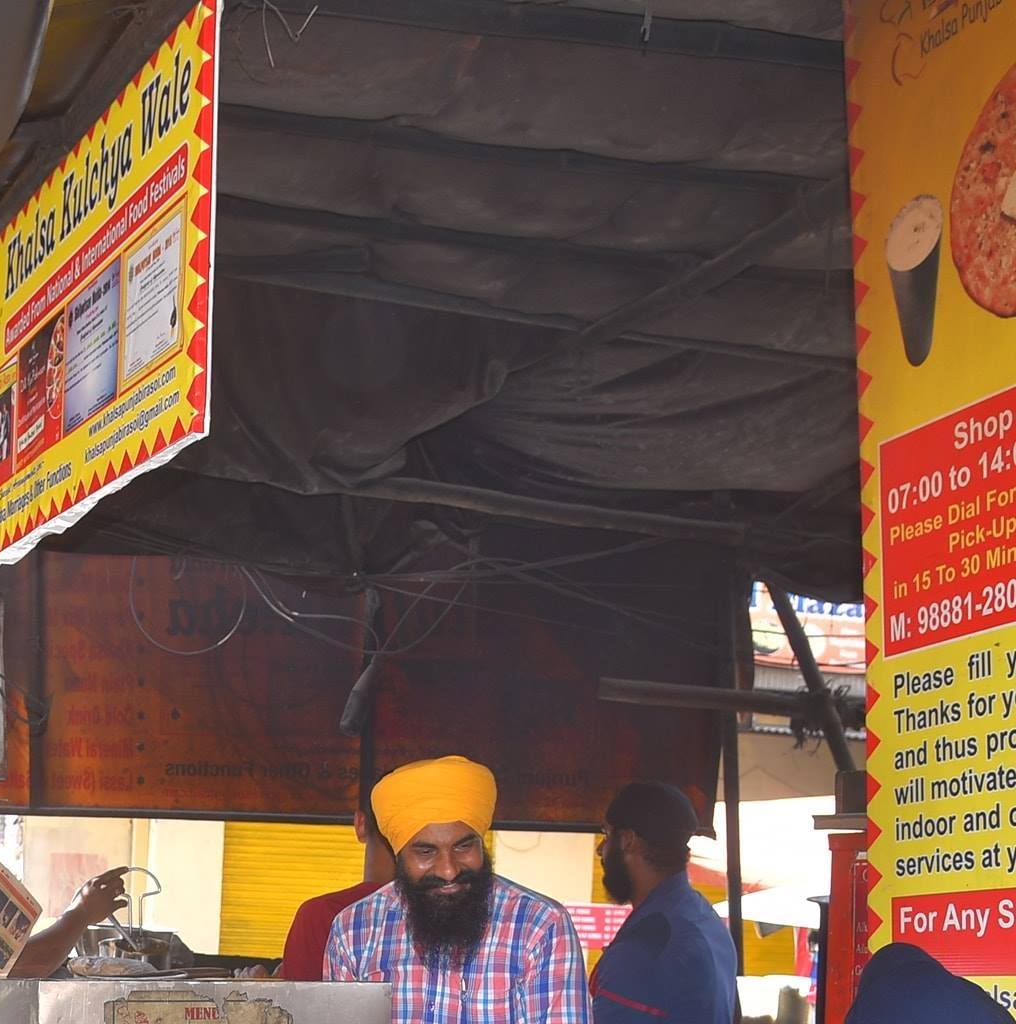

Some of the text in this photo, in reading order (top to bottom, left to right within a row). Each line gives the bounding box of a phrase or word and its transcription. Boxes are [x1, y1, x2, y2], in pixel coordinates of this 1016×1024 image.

[920, 18, 959, 57] Khalsa
[5, 206, 56, 299] Khalsa
[60, 122, 133, 243] Kulchya
[141, 48, 191, 157] Wale
[31, 293, 45, 323] From
[46, 264, 73, 304] National
[82, 216, 125, 270] International
[128, 190, 147, 225] Food
[149, 155, 185, 202] Festivals
[954, 409, 1013, 450] Shop
[47, 460, 72, 490] Functions
[888, 470, 943, 514] 07:00
[949, 464, 971, 491] to
[890, 487, 1016, 546] Please Dial For
[948, 515, 1016, 553] Pick-Up
[893, 580, 908, 600] in
[913, 570, 931, 593] 15
[935, 563, 956, 585] To
[961, 554, 980, 577] 30
[889, 578, 1016, 643] M: 98881-280
[894, 667, 954, 699] Please
[968, 650, 992, 681] fill
[893, 700, 961, 734] Thanks
[968, 692, 996, 719] for
[895, 740, 927, 770] and
[934, 736, 977, 765] thus
[894, 765, 1016, 805] will motivate
[895, 814, 956, 841] indoor
[963, 803, 1000, 832] and
[895, 848, 974, 877] services
[981, 843, 1000, 868] at
[899, 906, 937, 934] For
[942, 903, 990, 938] Any
